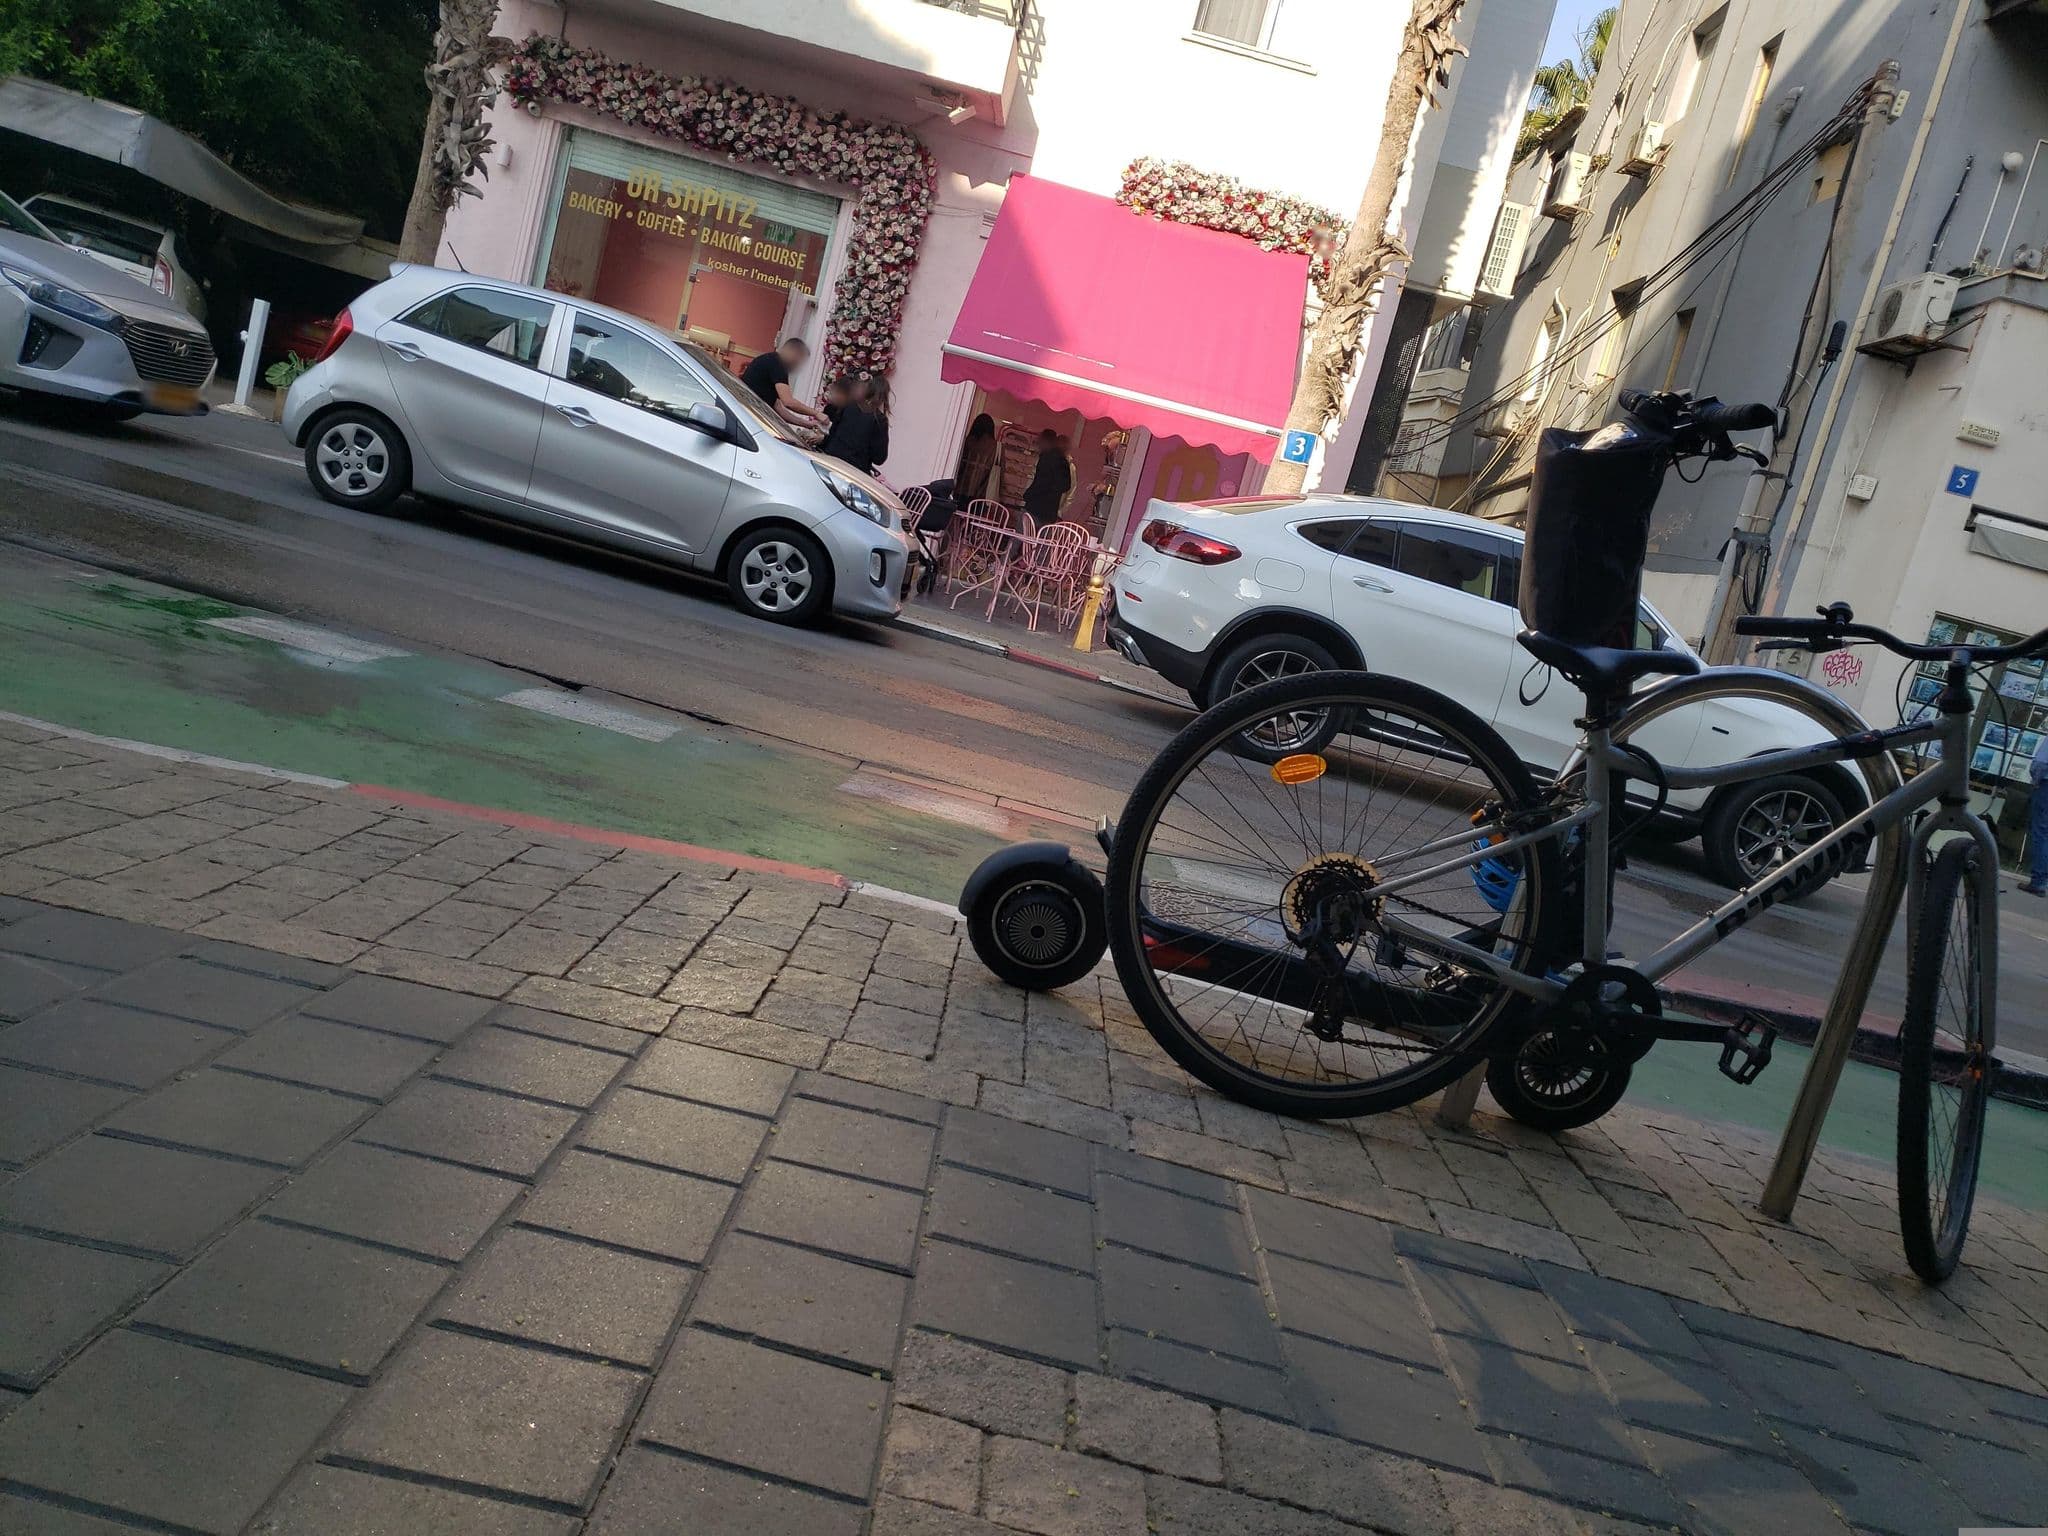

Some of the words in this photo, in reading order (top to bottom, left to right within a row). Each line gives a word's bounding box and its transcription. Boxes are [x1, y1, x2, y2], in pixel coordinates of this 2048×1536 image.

[627, 167, 662, 203] OR
[667, 178, 757, 229] SHPITZ
[568, 191, 623, 219] BAKERY
[637, 210, 687, 237] COFFEE
[700, 227, 751, 255] BAKING
[754, 242, 807, 270] COURSE
[708, 257, 749, 276] kosher
[1292, 437, 1306, 455] 3
[1956, 474, 1970, 489] 5
